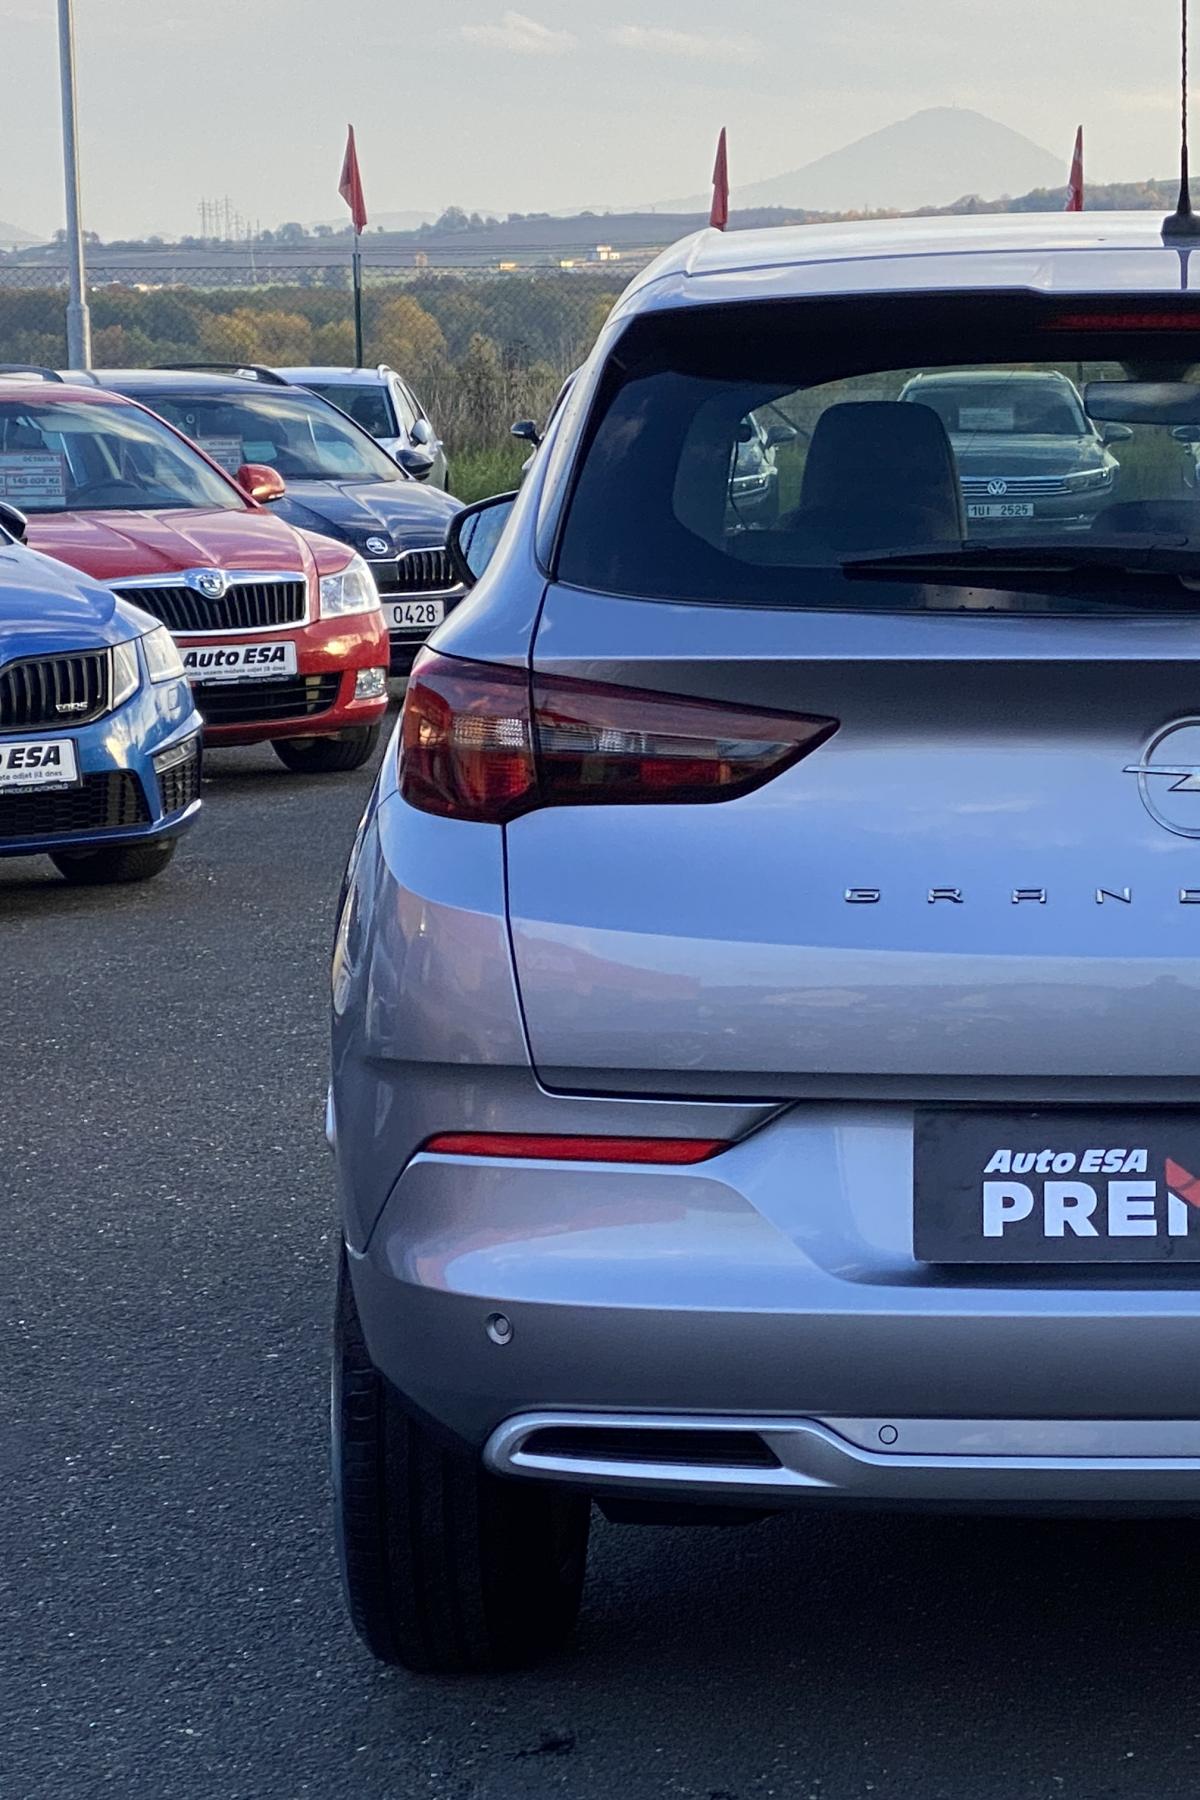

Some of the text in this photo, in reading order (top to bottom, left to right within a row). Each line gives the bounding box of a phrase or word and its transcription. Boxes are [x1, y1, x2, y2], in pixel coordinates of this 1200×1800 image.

[393, 604, 436, 624] 0428
[183, 646, 285, 668] Auto ESA
[6, 745, 61, 769] ESA
[983, 1149, 1149, 1174] Auto ESA
